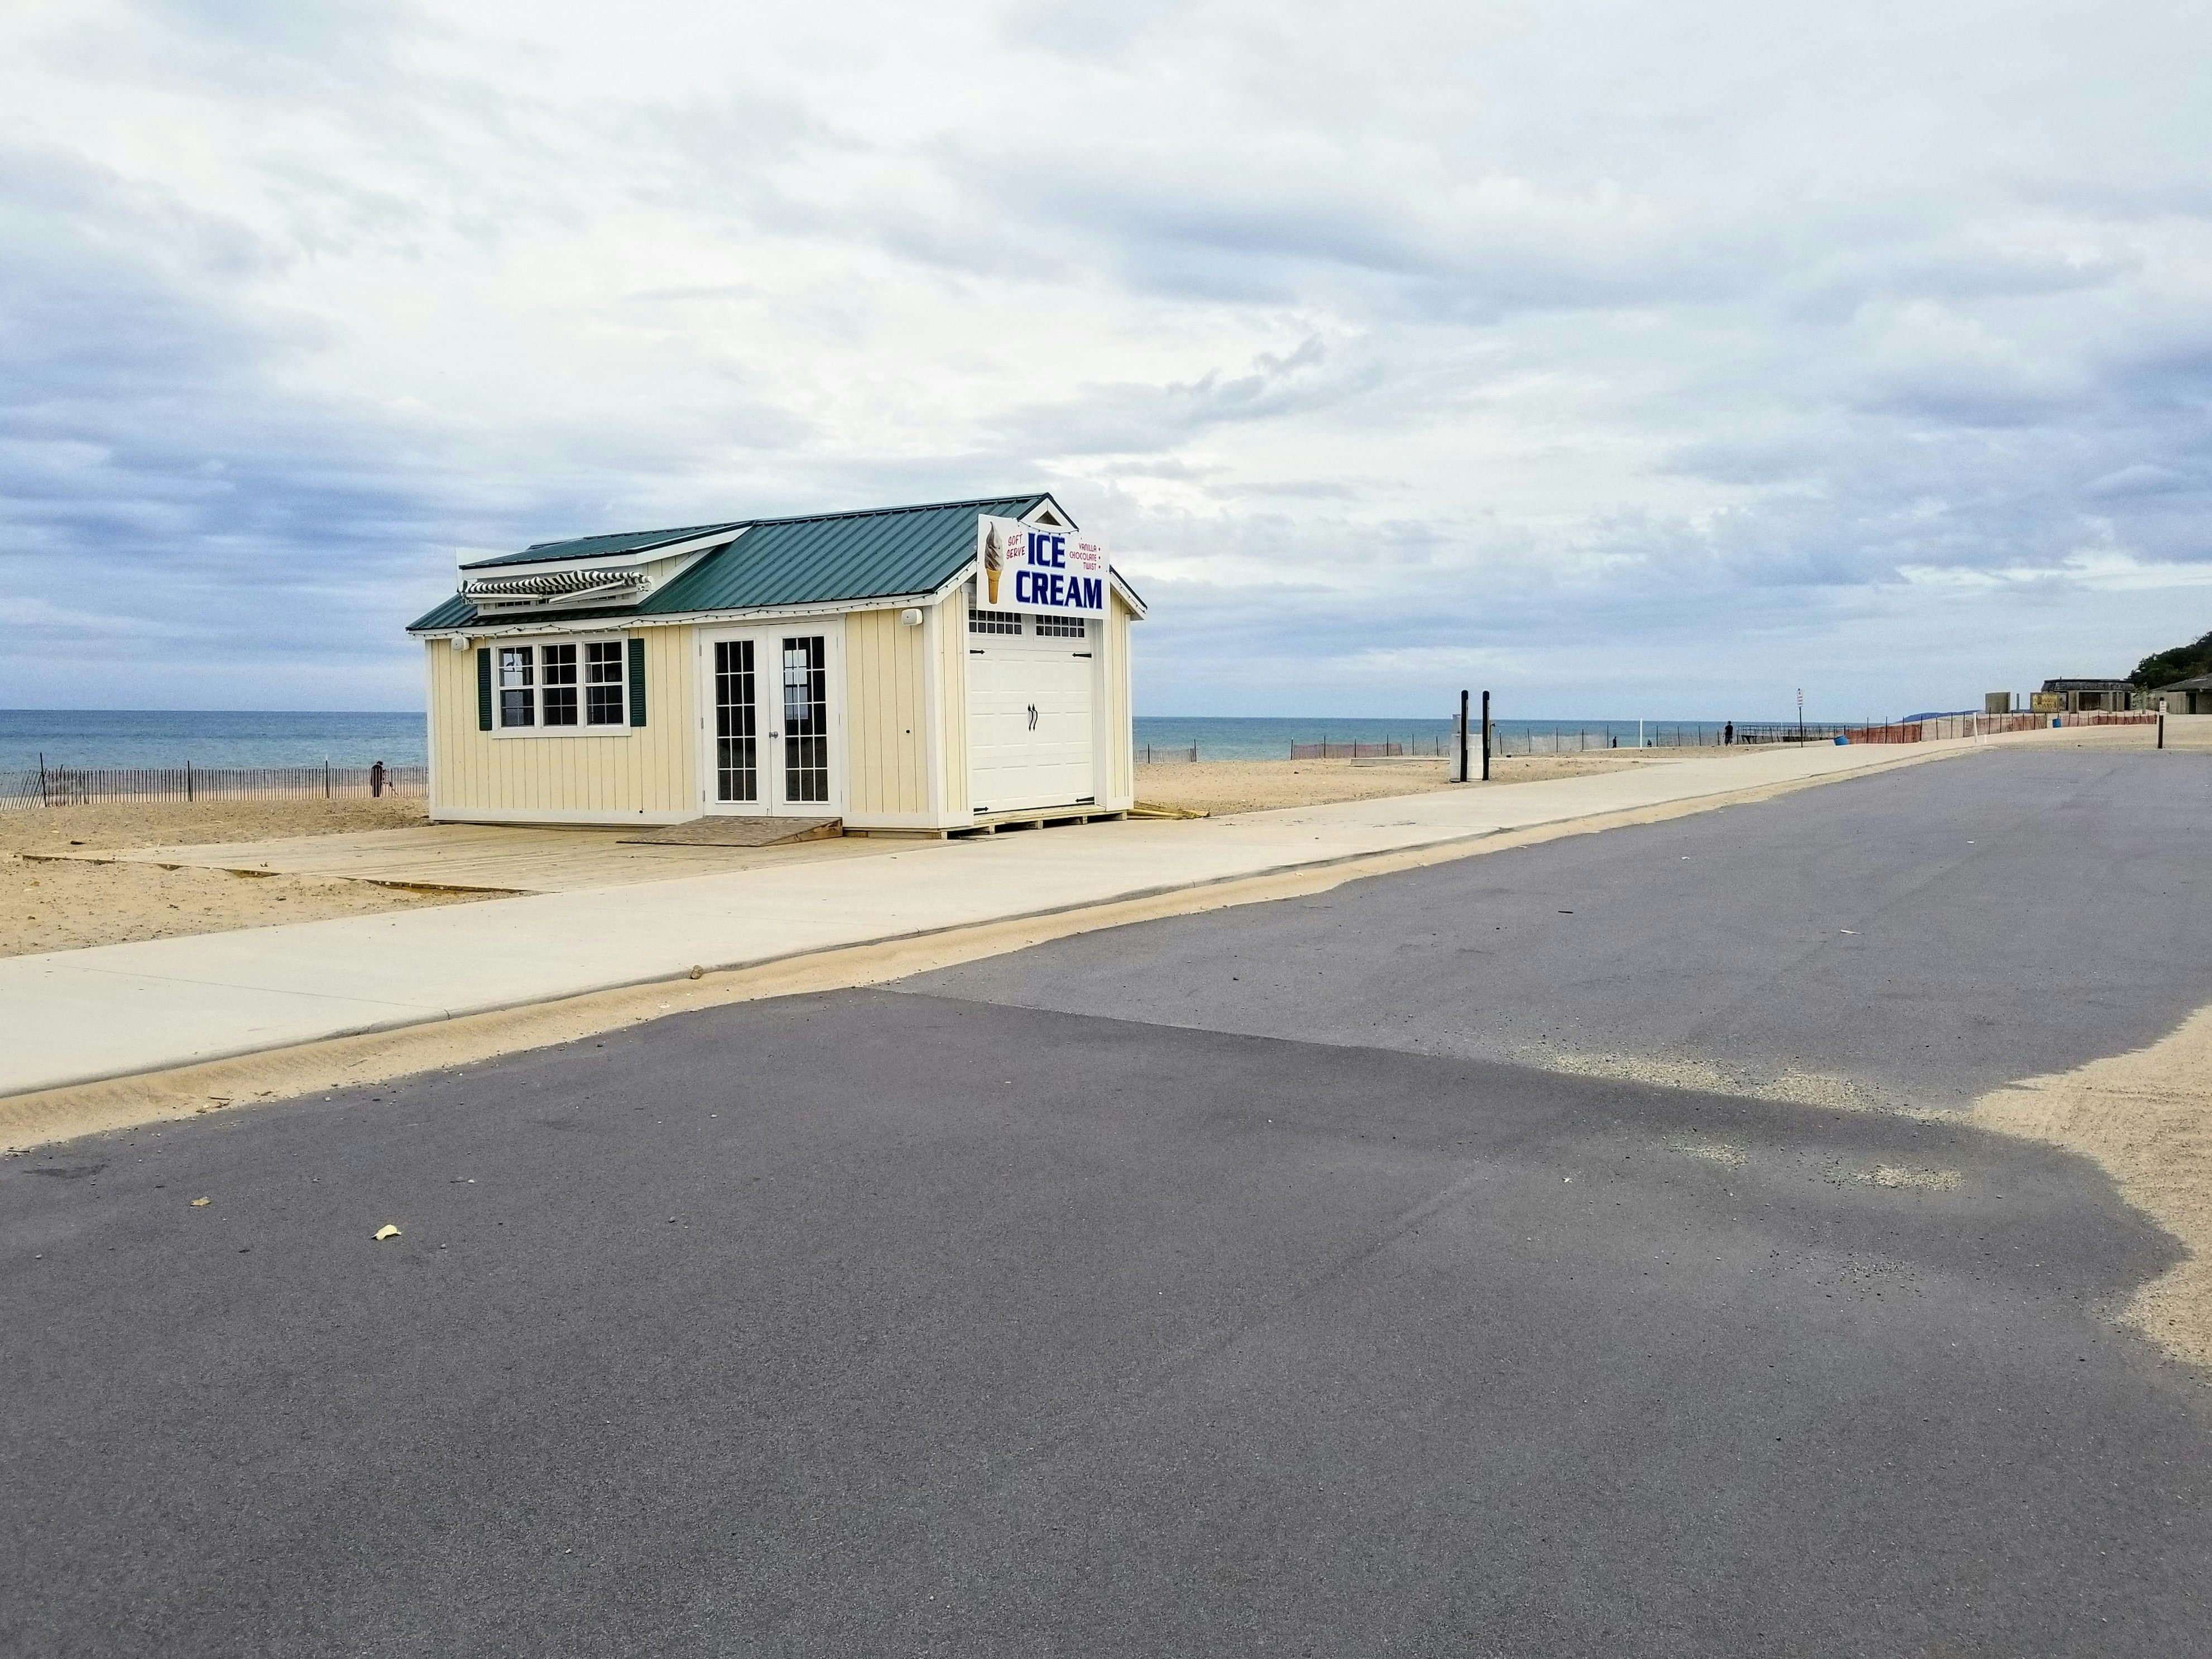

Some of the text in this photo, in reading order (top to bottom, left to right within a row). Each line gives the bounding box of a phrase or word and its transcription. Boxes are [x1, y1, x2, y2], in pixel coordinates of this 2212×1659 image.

[1008, 534, 1023, 546] SOFT
[1006, 546, 1025, 559] SERVE
[1028, 532, 1066, 568] ICE
[1078, 543, 1097, 552] VANILLA
[1069, 551, 1097, 561] CHOCOLATE
[1083, 562, 1097, 570] TWIST
[1016, 570, 1102, 610] CREAM
